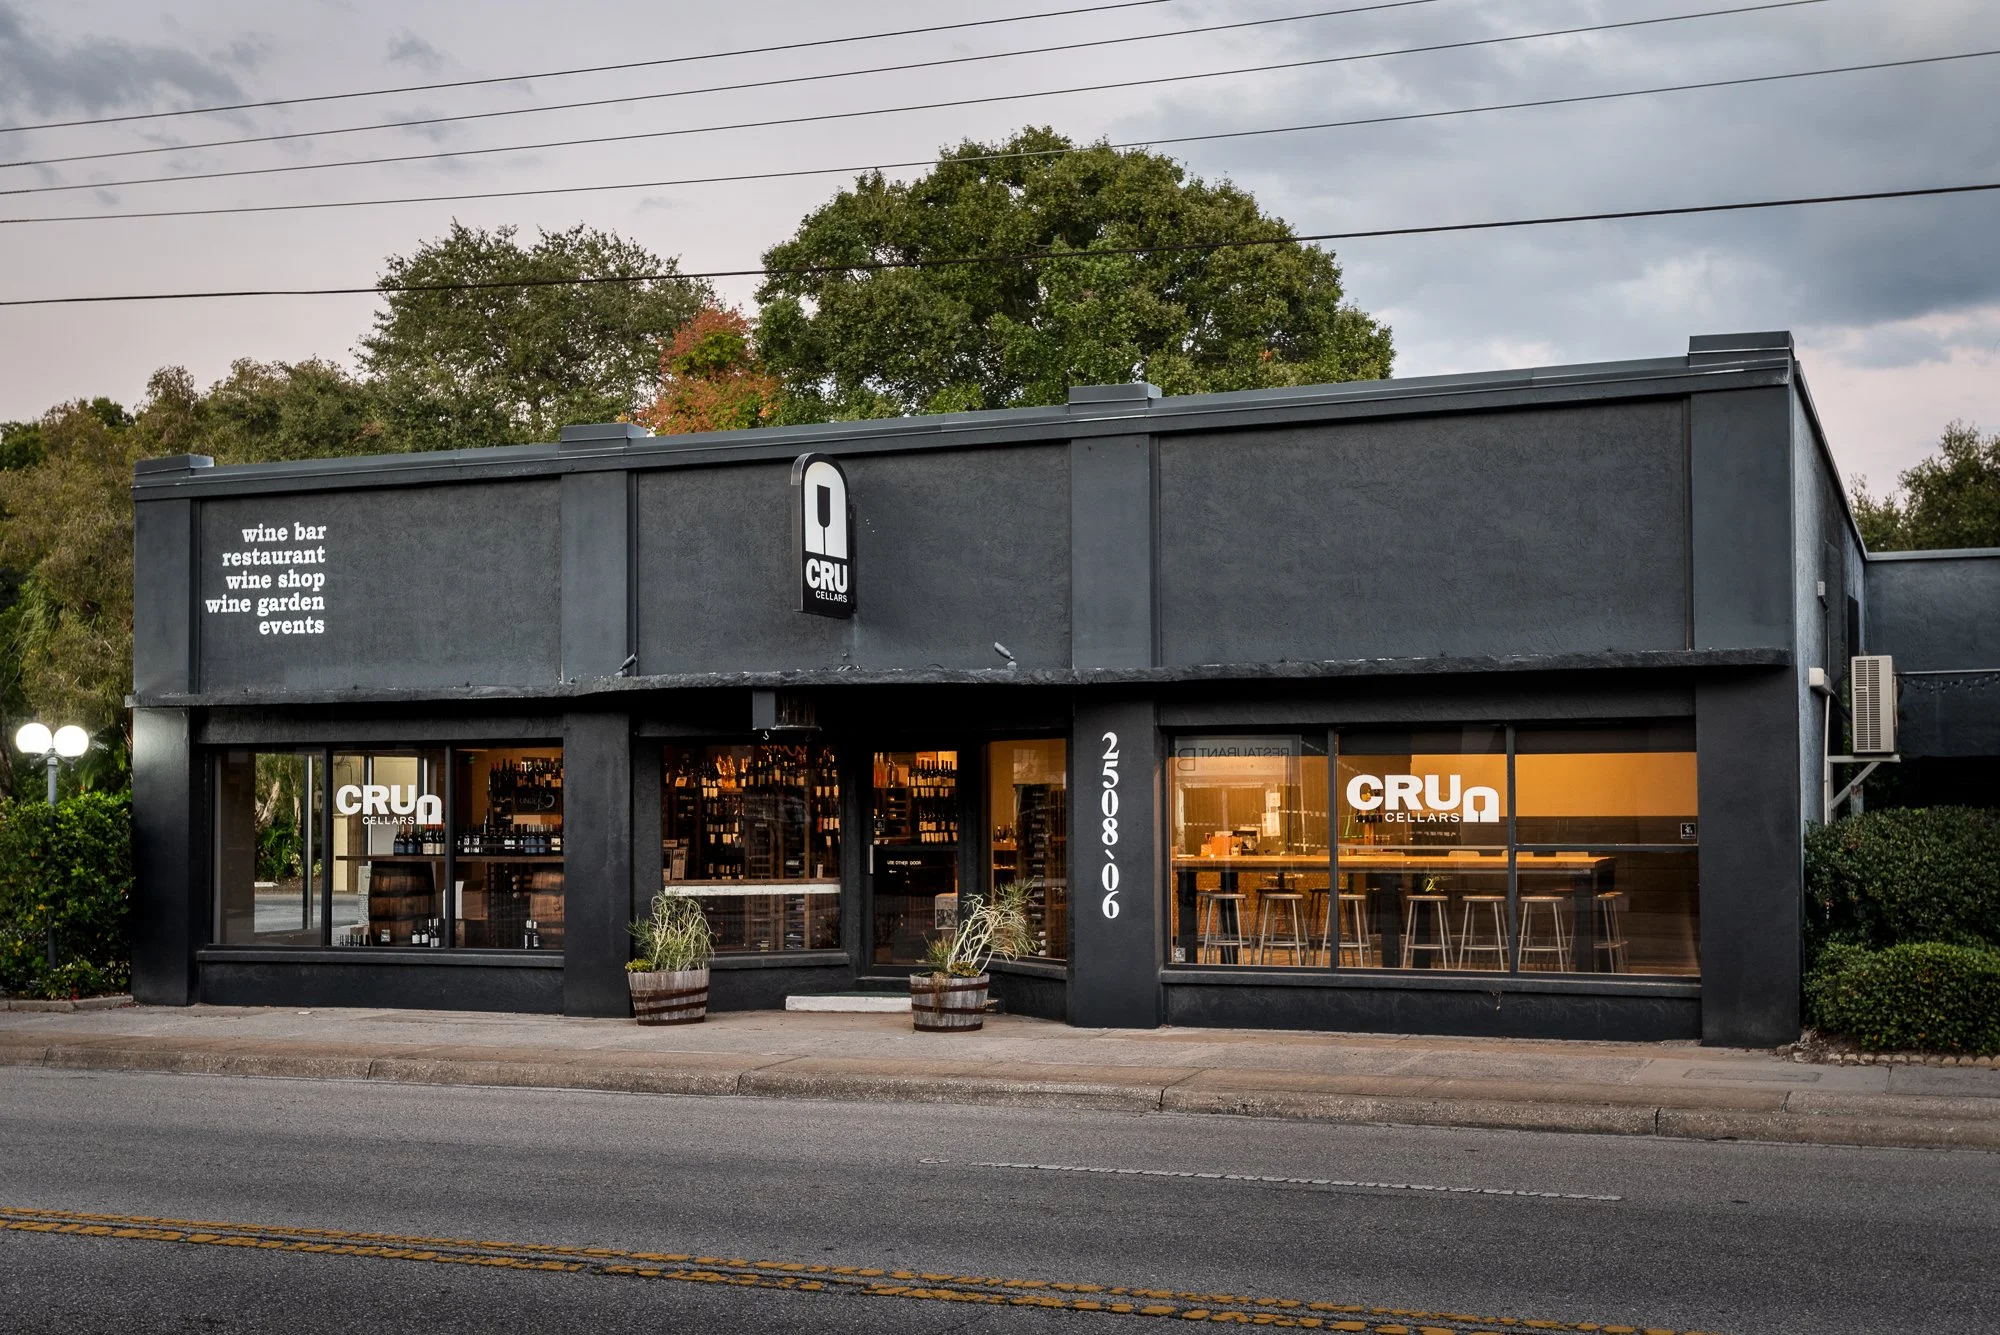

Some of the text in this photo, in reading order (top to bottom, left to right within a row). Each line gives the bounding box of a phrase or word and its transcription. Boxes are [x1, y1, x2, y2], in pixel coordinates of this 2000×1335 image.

[241, 521, 327, 543] wine bar
[222, 545, 326, 567] restaurant
[225, 568, 326, 592] wine shop
[805, 558, 848, 594] CRU
[205, 592, 325, 617] wine garden
[815, 590, 848, 603] CELLARS
[259, 616, 325, 635] events
[336, 784, 416, 816] CRU
[1346, 774, 1461, 811] CRU
[362, 816, 415, 825] CELLARS
[1384, 812, 1461, 823] CELLARS
